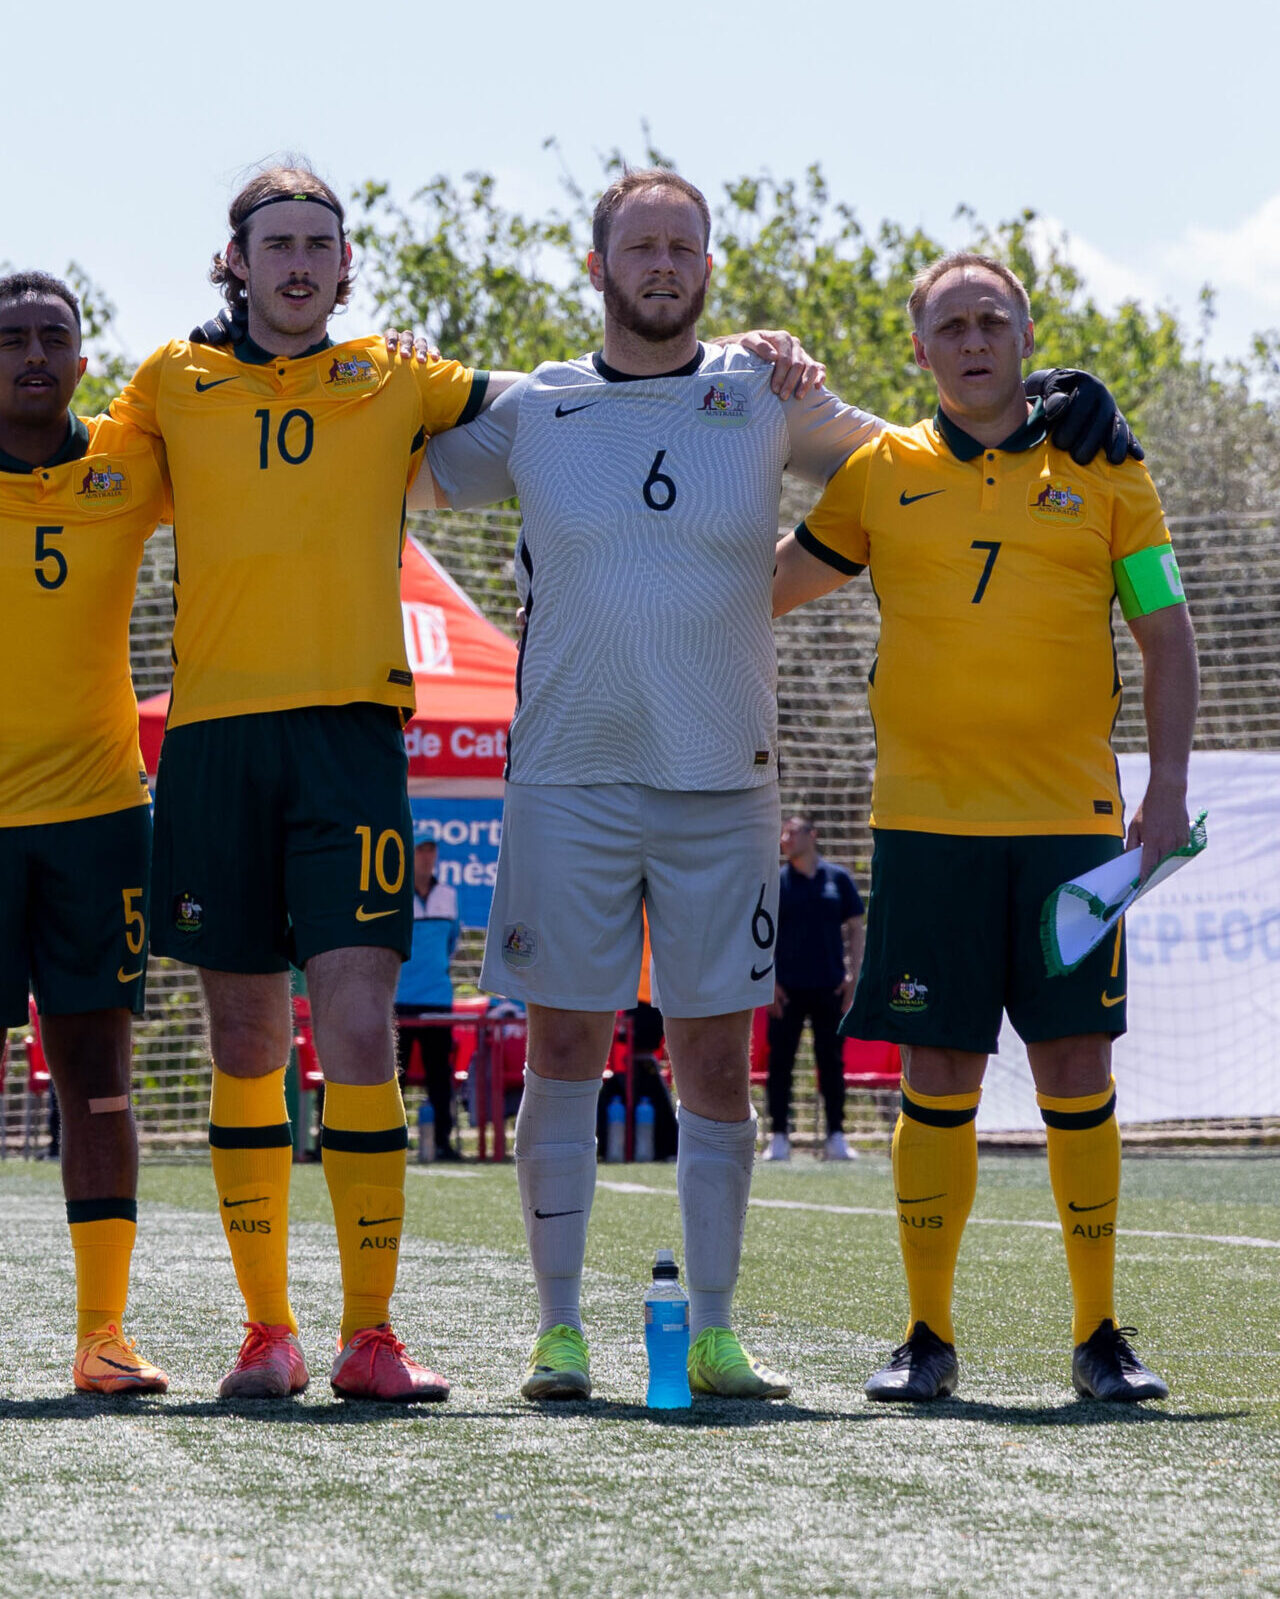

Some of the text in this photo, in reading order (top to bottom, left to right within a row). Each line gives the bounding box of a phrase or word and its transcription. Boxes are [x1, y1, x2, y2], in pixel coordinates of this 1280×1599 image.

[255, 408, 314, 469] 10
[643, 450, 677, 511] 6
[35, 525, 68, 590] 5
[970, 540, 1001, 604] 7
[404, 726, 442, 757] de
[413, 819, 502, 846] port
[355, 825, 405, 893] 10
[432, 853, 497, 886] nès
[122, 888, 145, 954] 5
[751, 883, 775, 949] 6
[229, 1219, 271, 1234] AUS
[359, 1236, 398, 1251] AUS
[900, 1213, 944, 1229] AUS
[1072, 1221, 1114, 1239] AUS
